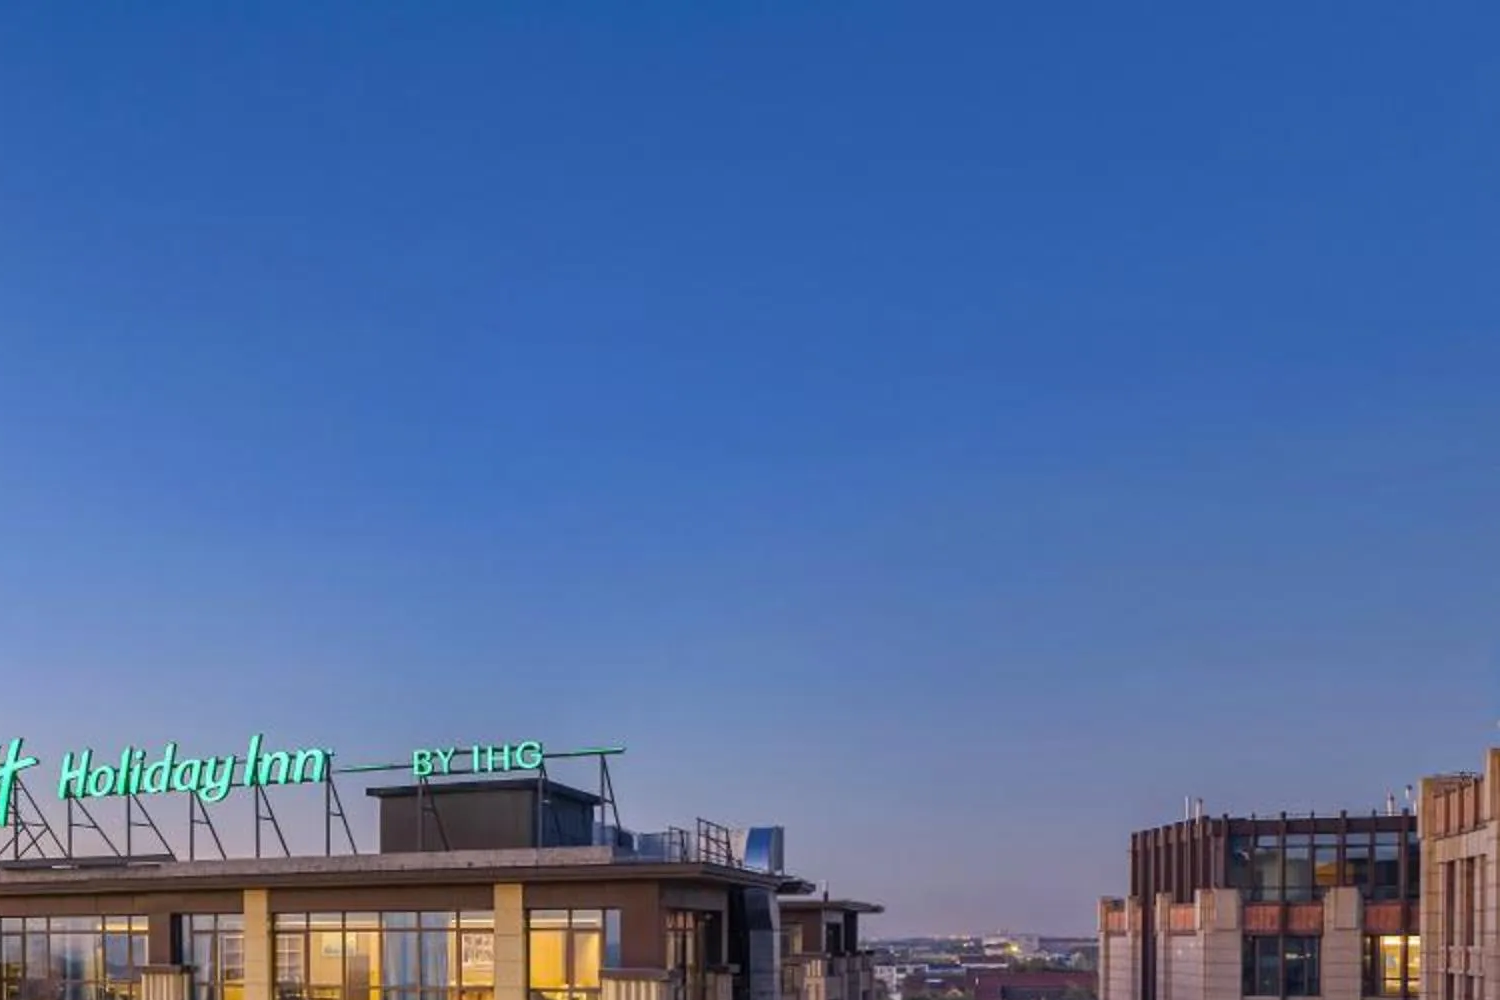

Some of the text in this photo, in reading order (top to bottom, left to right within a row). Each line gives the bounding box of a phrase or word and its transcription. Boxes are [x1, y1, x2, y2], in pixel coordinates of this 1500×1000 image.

[58, 741, 237, 803] Holiday
[244, 734, 329, 787] Inn
[412, 741, 544, 777] BY IHG
